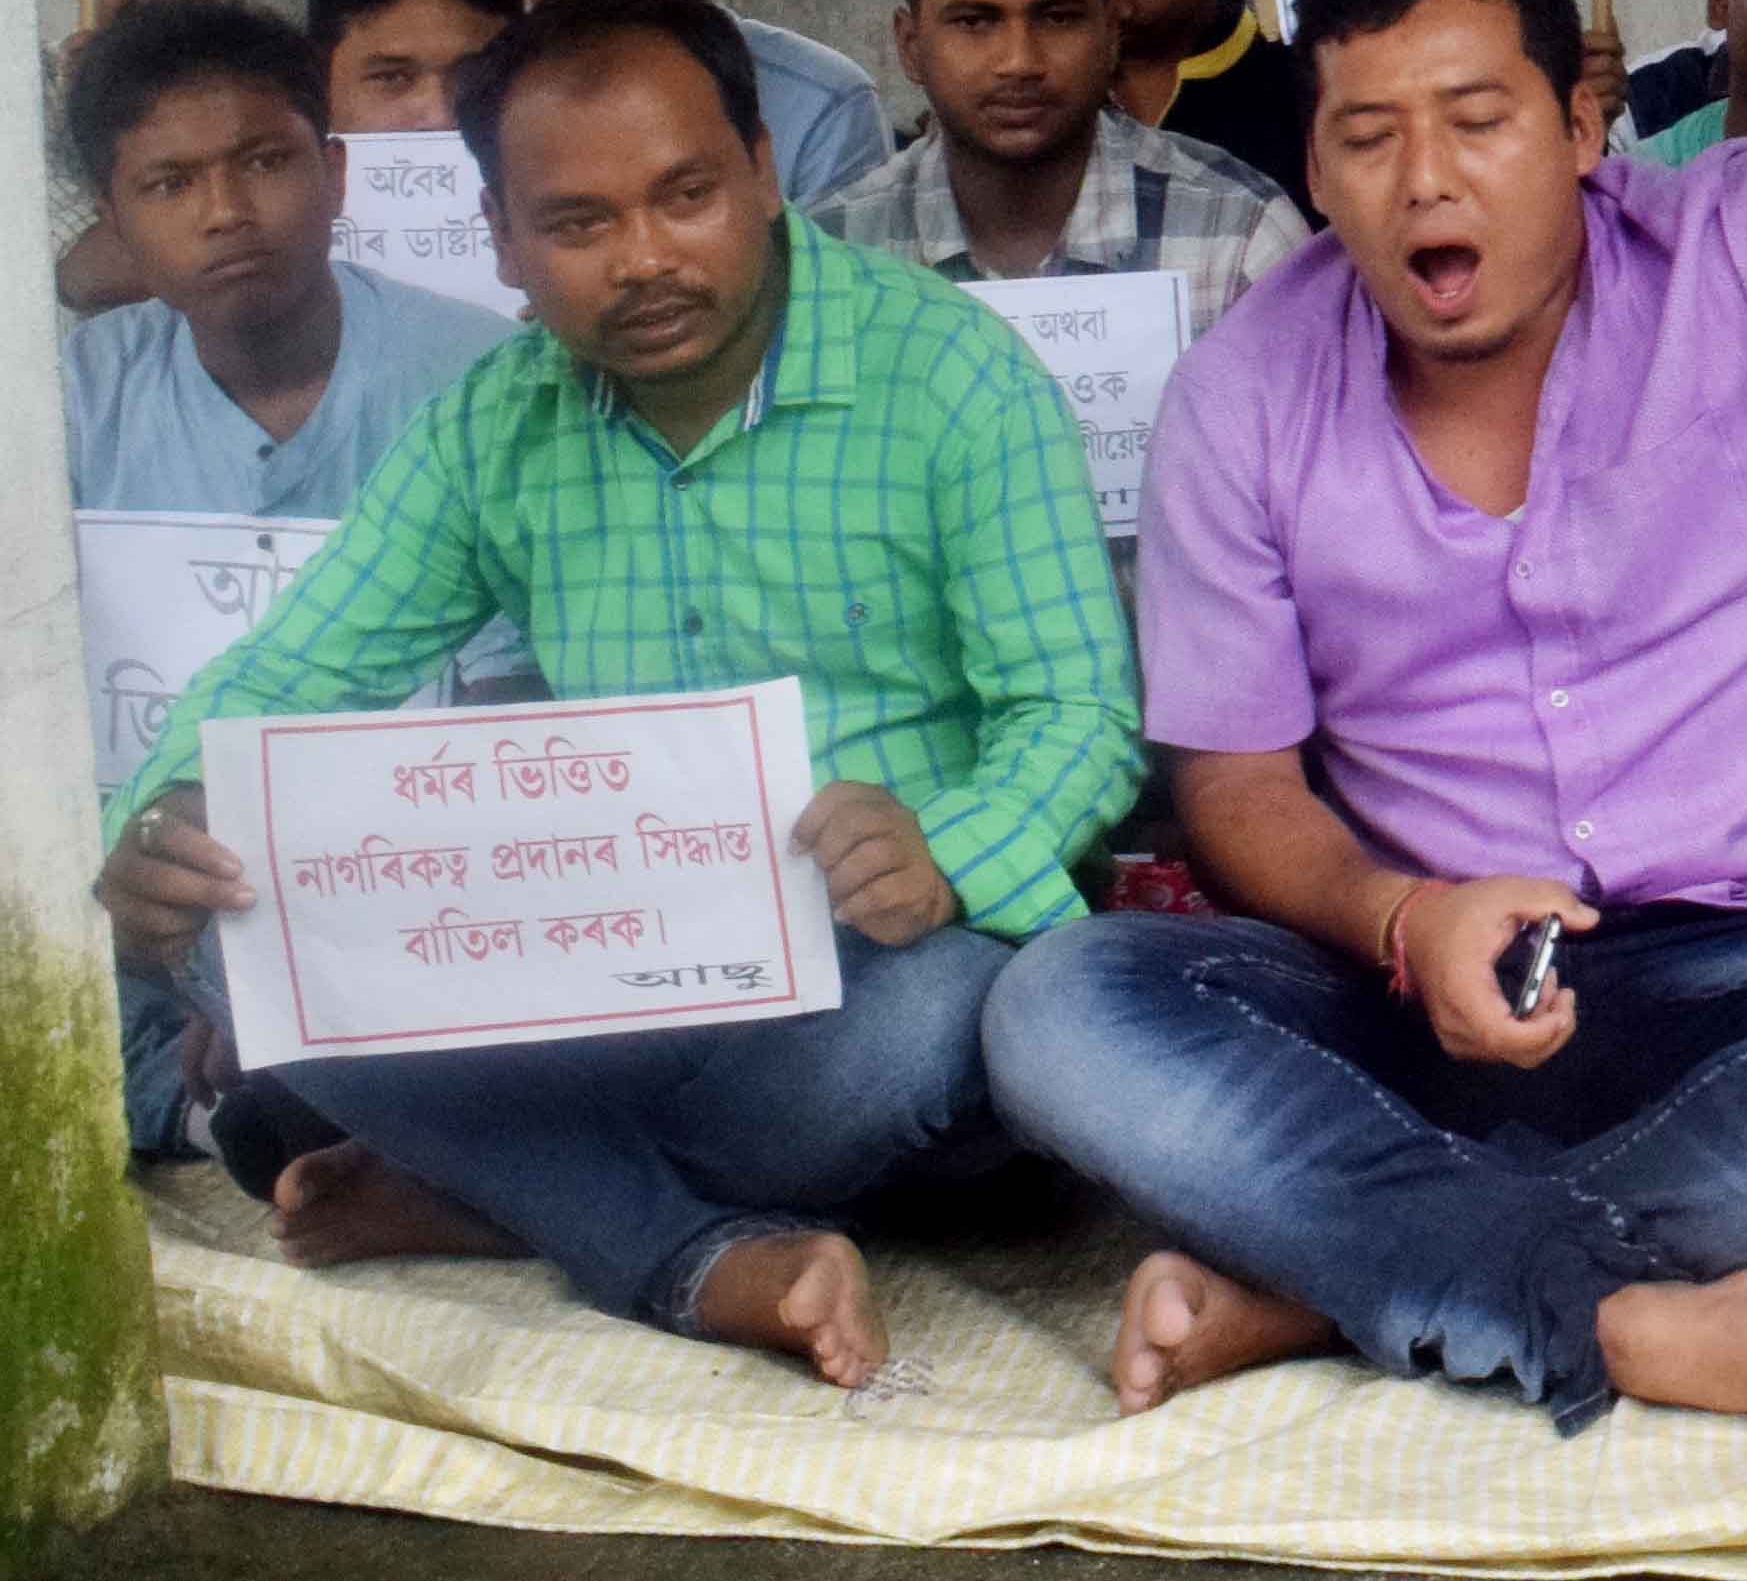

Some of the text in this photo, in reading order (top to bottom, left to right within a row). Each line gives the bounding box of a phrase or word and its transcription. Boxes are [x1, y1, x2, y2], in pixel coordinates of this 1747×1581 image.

[392, 735, 632, 809] ধৰ্মৰ ভিত্তিত
[291, 834, 470, 898] নাগৰিকত্ব
[490, 833, 619, 883] প্ৰদানৰ
[396, 906, 525, 966] বাতিল
